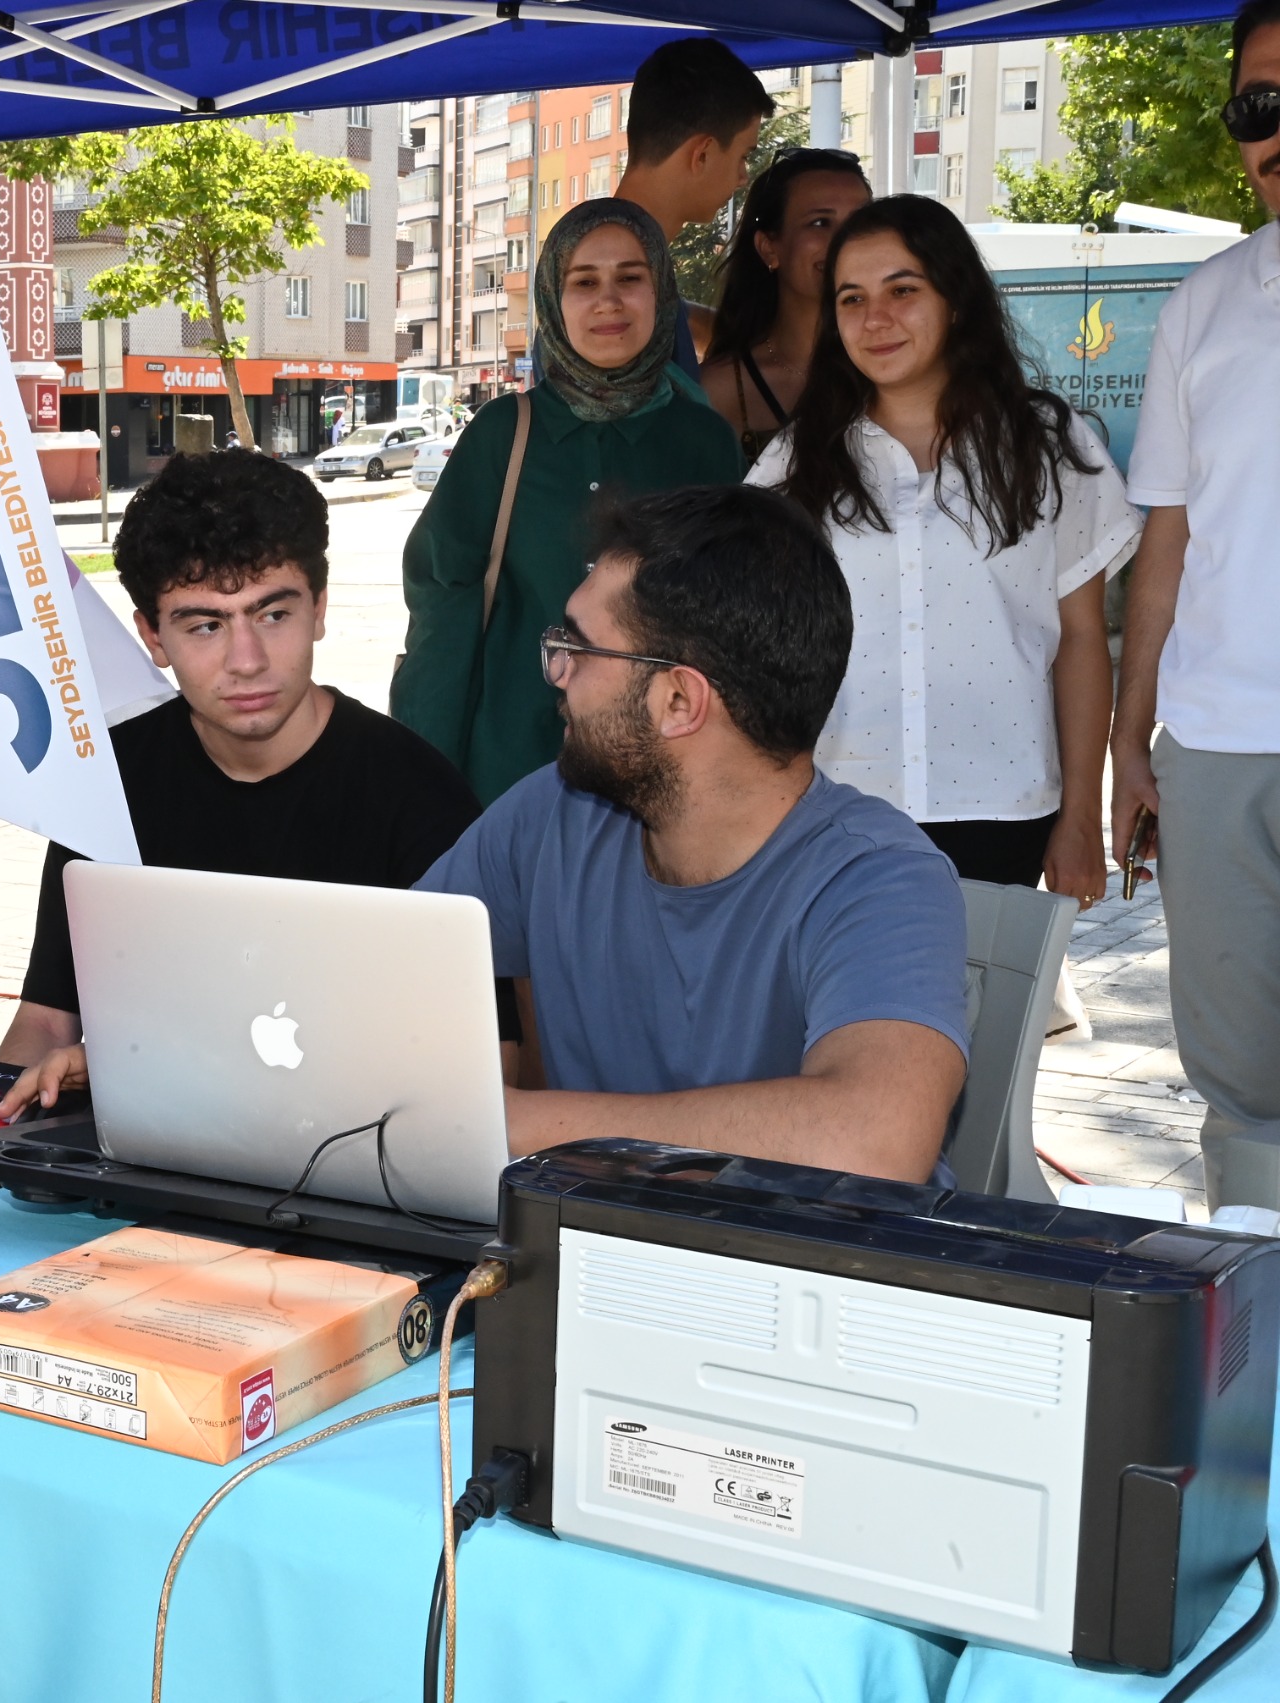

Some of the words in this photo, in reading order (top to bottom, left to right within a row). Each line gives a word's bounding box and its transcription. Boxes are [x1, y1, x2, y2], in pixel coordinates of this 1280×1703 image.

[32, 591, 95, 759] SEYDİŞEHİR
[57, 1373, 73, 1387] A4
[111, 1371, 133, 1387] 500
[614, 1422, 644, 1432] SAMSUNG
[724, 1446, 754, 1462] LASER
[755, 1453, 796, 1471] PRINTER
[751, 1503, 773, 1514] PRODUCT
[733, 1513, 749, 1522] MADE
[756, 1519, 773, 1528] CHINA
